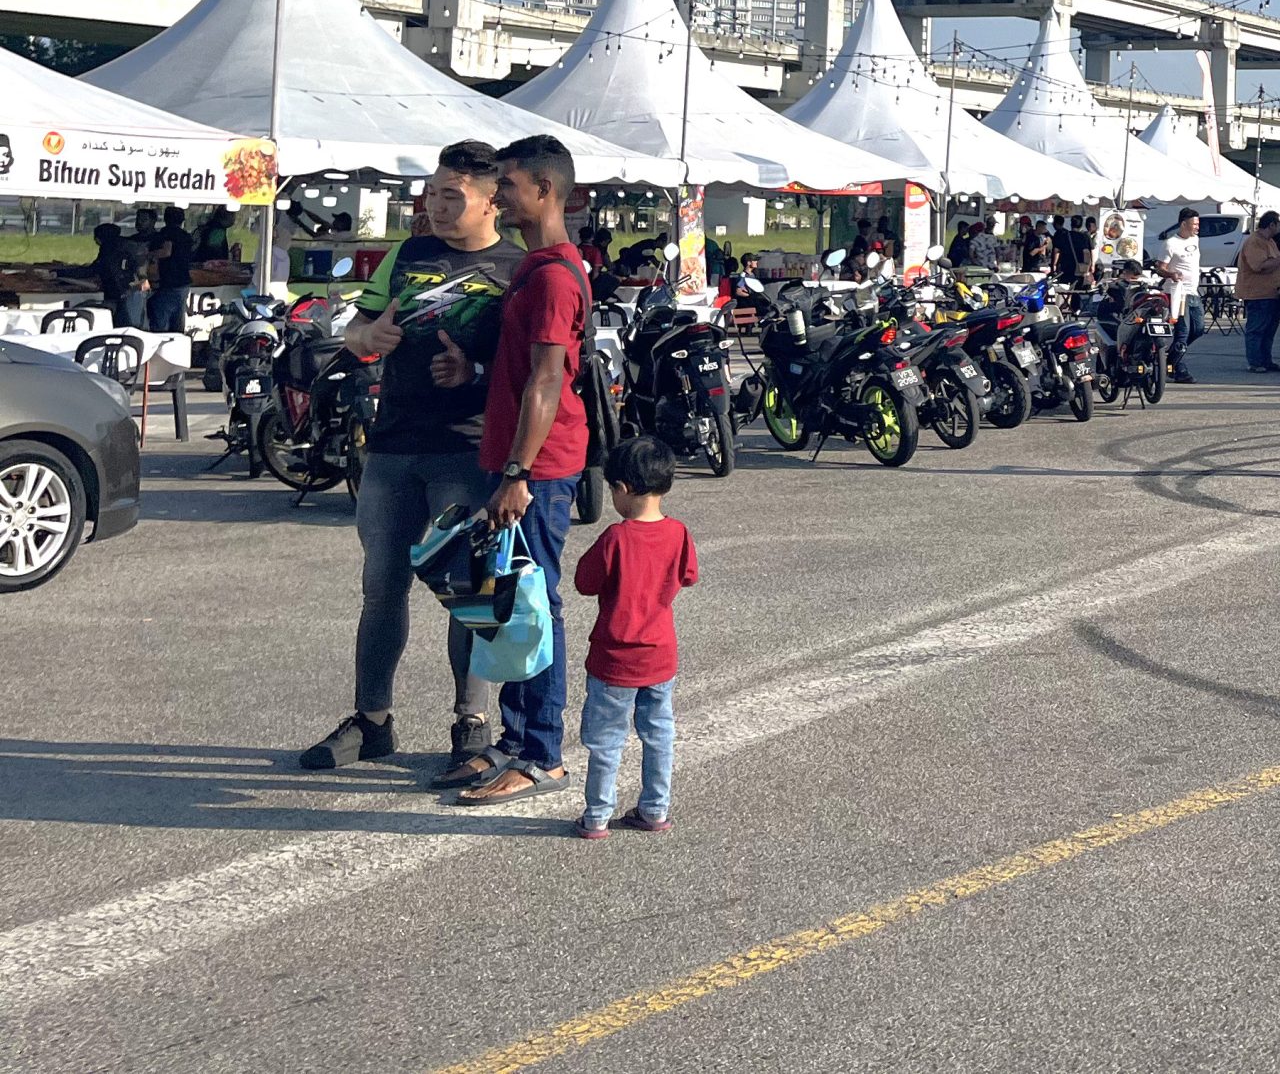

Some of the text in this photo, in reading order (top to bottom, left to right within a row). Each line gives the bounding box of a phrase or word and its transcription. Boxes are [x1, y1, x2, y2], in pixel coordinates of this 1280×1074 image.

[39, 159, 216, 193] Bihun Sup Kedah
